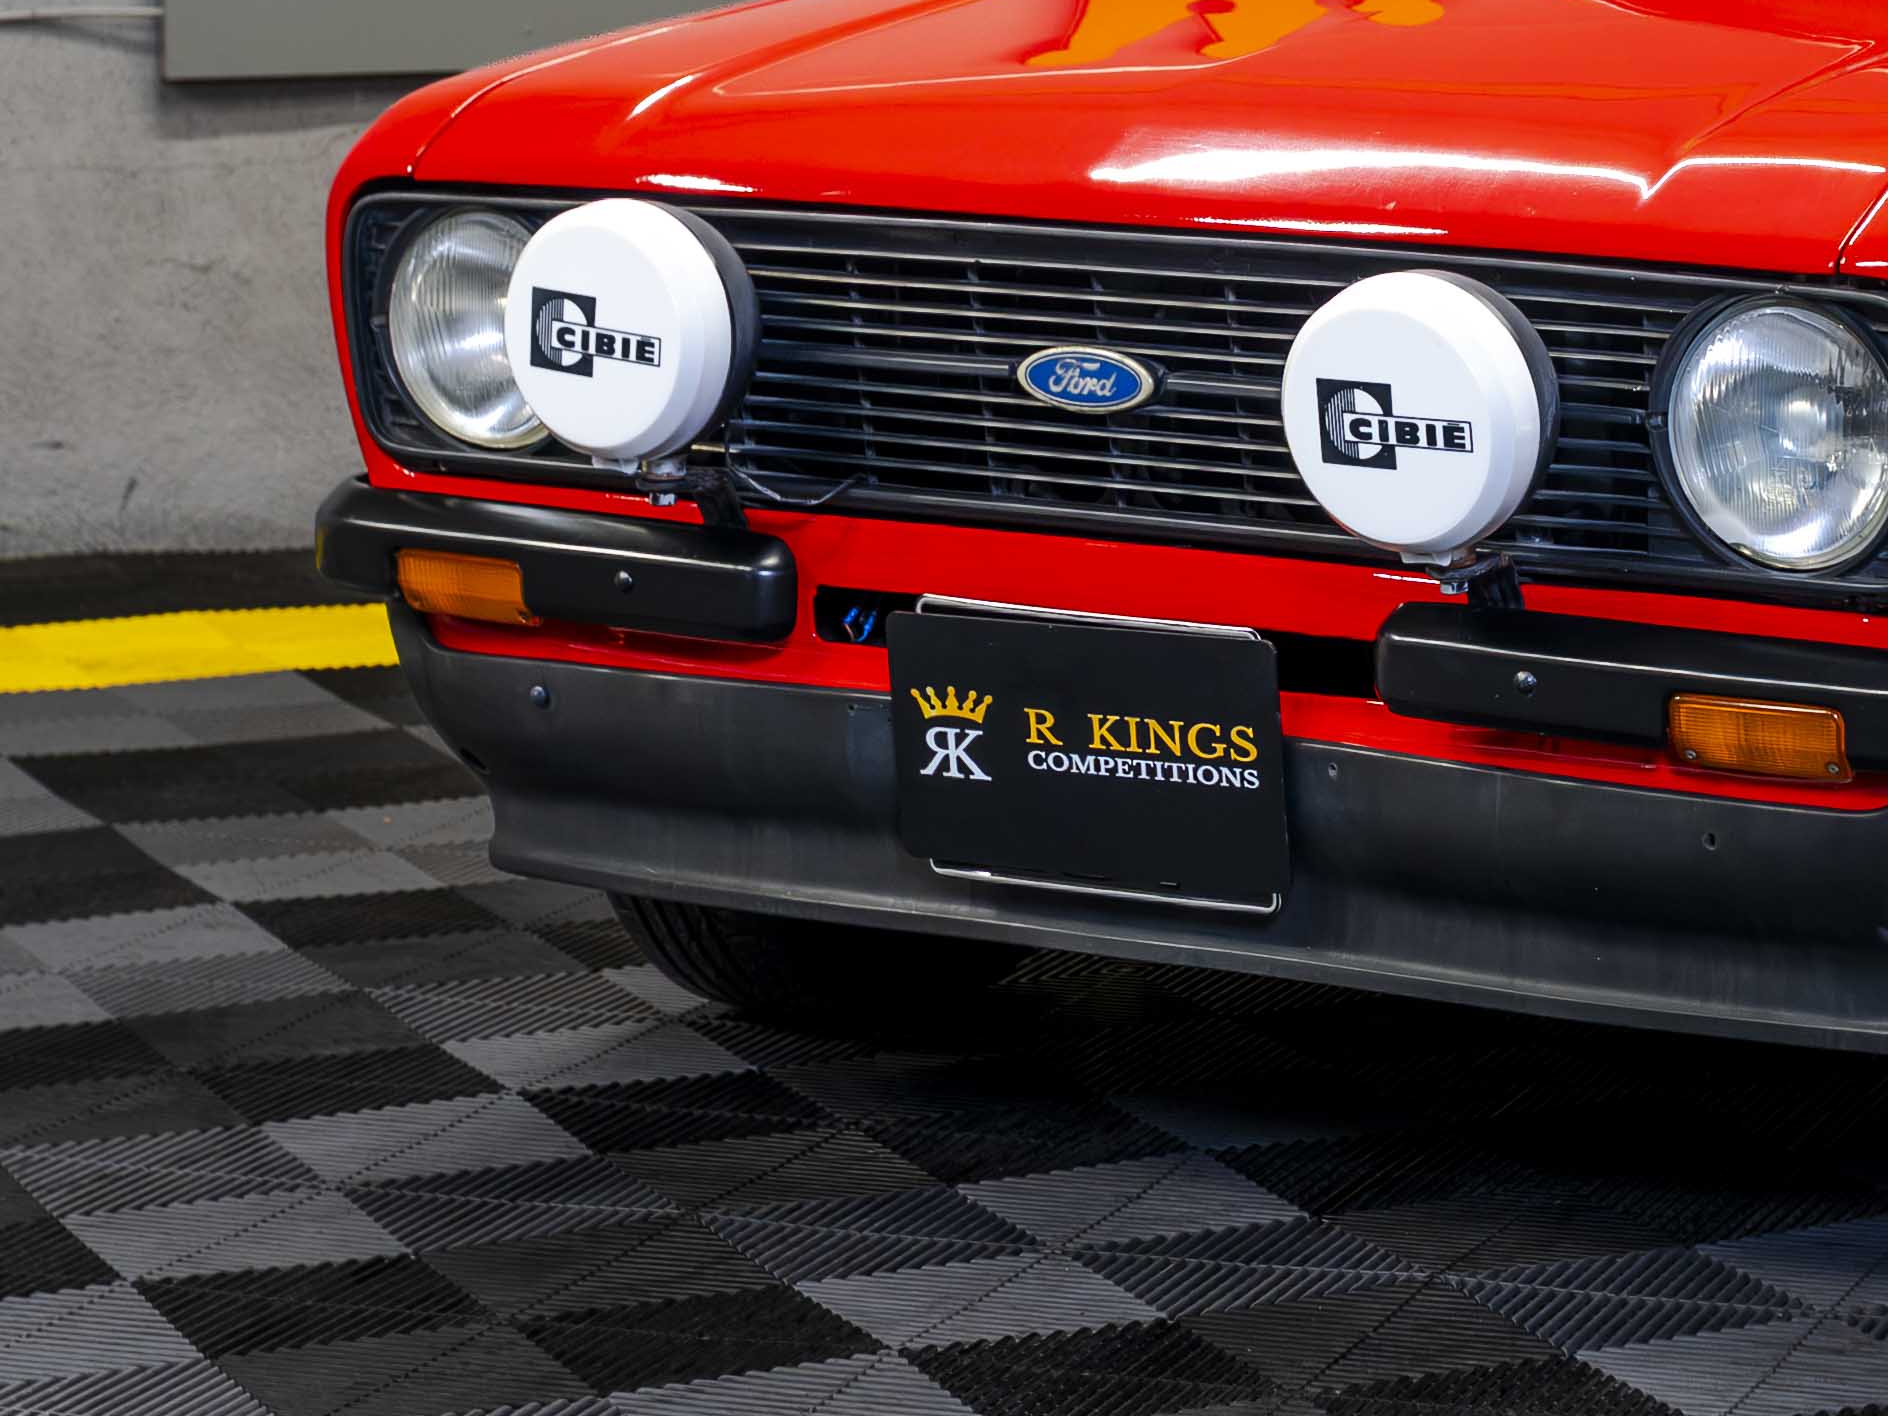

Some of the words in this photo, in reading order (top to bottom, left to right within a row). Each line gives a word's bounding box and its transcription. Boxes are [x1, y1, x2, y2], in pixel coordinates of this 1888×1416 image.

[1048, 357, 1117, 398] Ford
[1023, 707, 1064, 747] R
[1087, 713, 1259, 763] KINGS
[1026, 750, 1260, 790] COMPETITIONS
